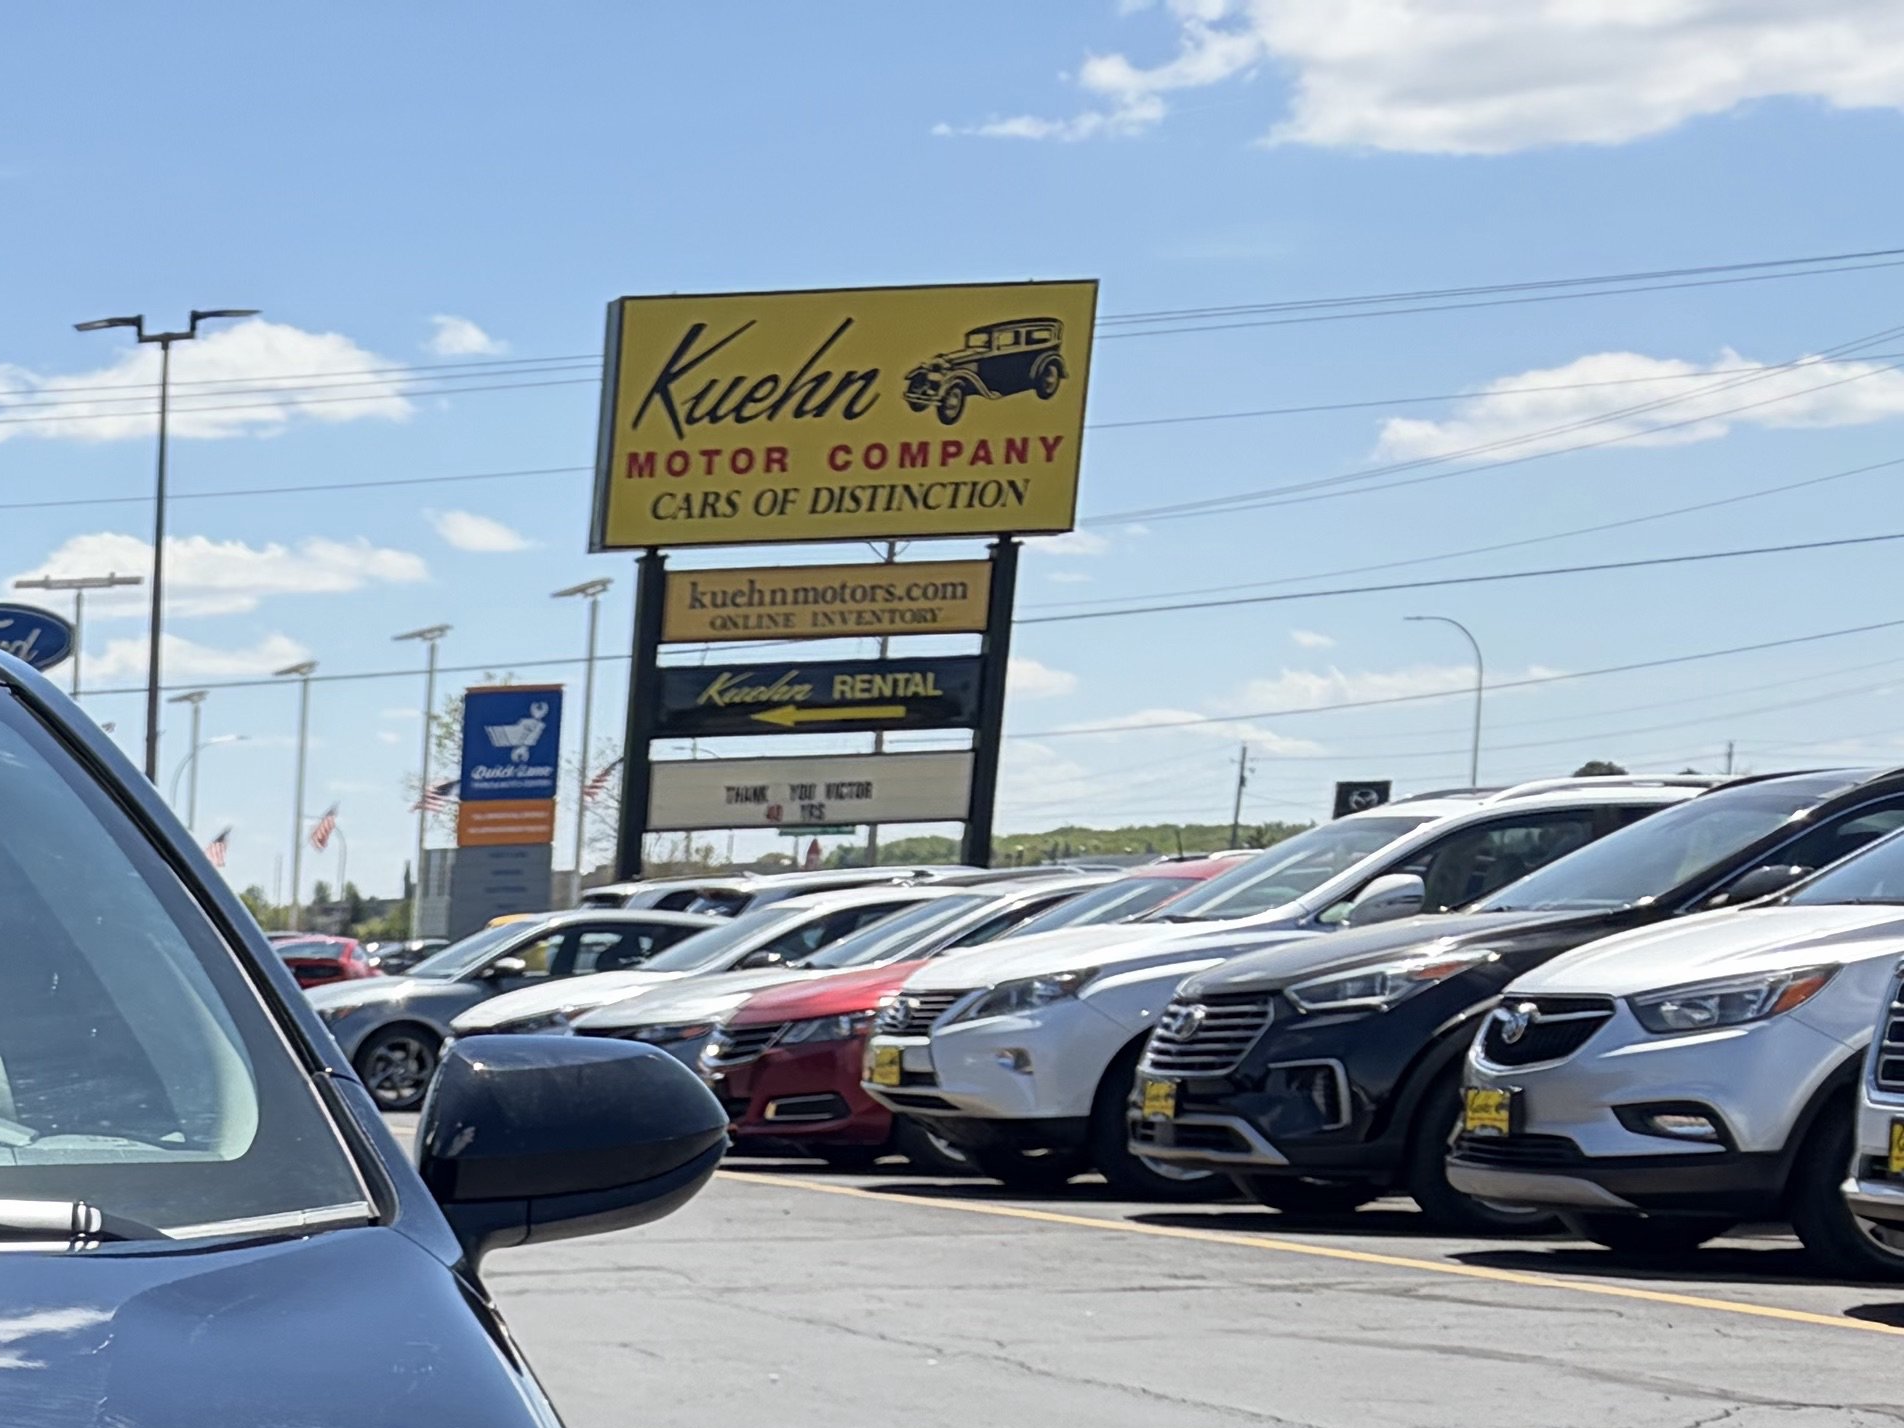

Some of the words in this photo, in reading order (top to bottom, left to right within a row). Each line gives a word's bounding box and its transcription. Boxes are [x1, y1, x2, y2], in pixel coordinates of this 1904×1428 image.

[631, 317, 882, 440] Kuehn
[625, 446, 790, 479] MOTOR
[827, 435, 1065, 472] COMPANY
[650, 489, 742, 521] CARS
[754, 487, 799, 518] OF
[808, 478, 1031, 515] DISTINCTION
[688, 579, 969, 610] kuehnmotors.com
[710, 612, 795, 631] ONLINE
[812, 608, 943, 628] INVENTORY
[832, 672, 943, 700] RENTAL
